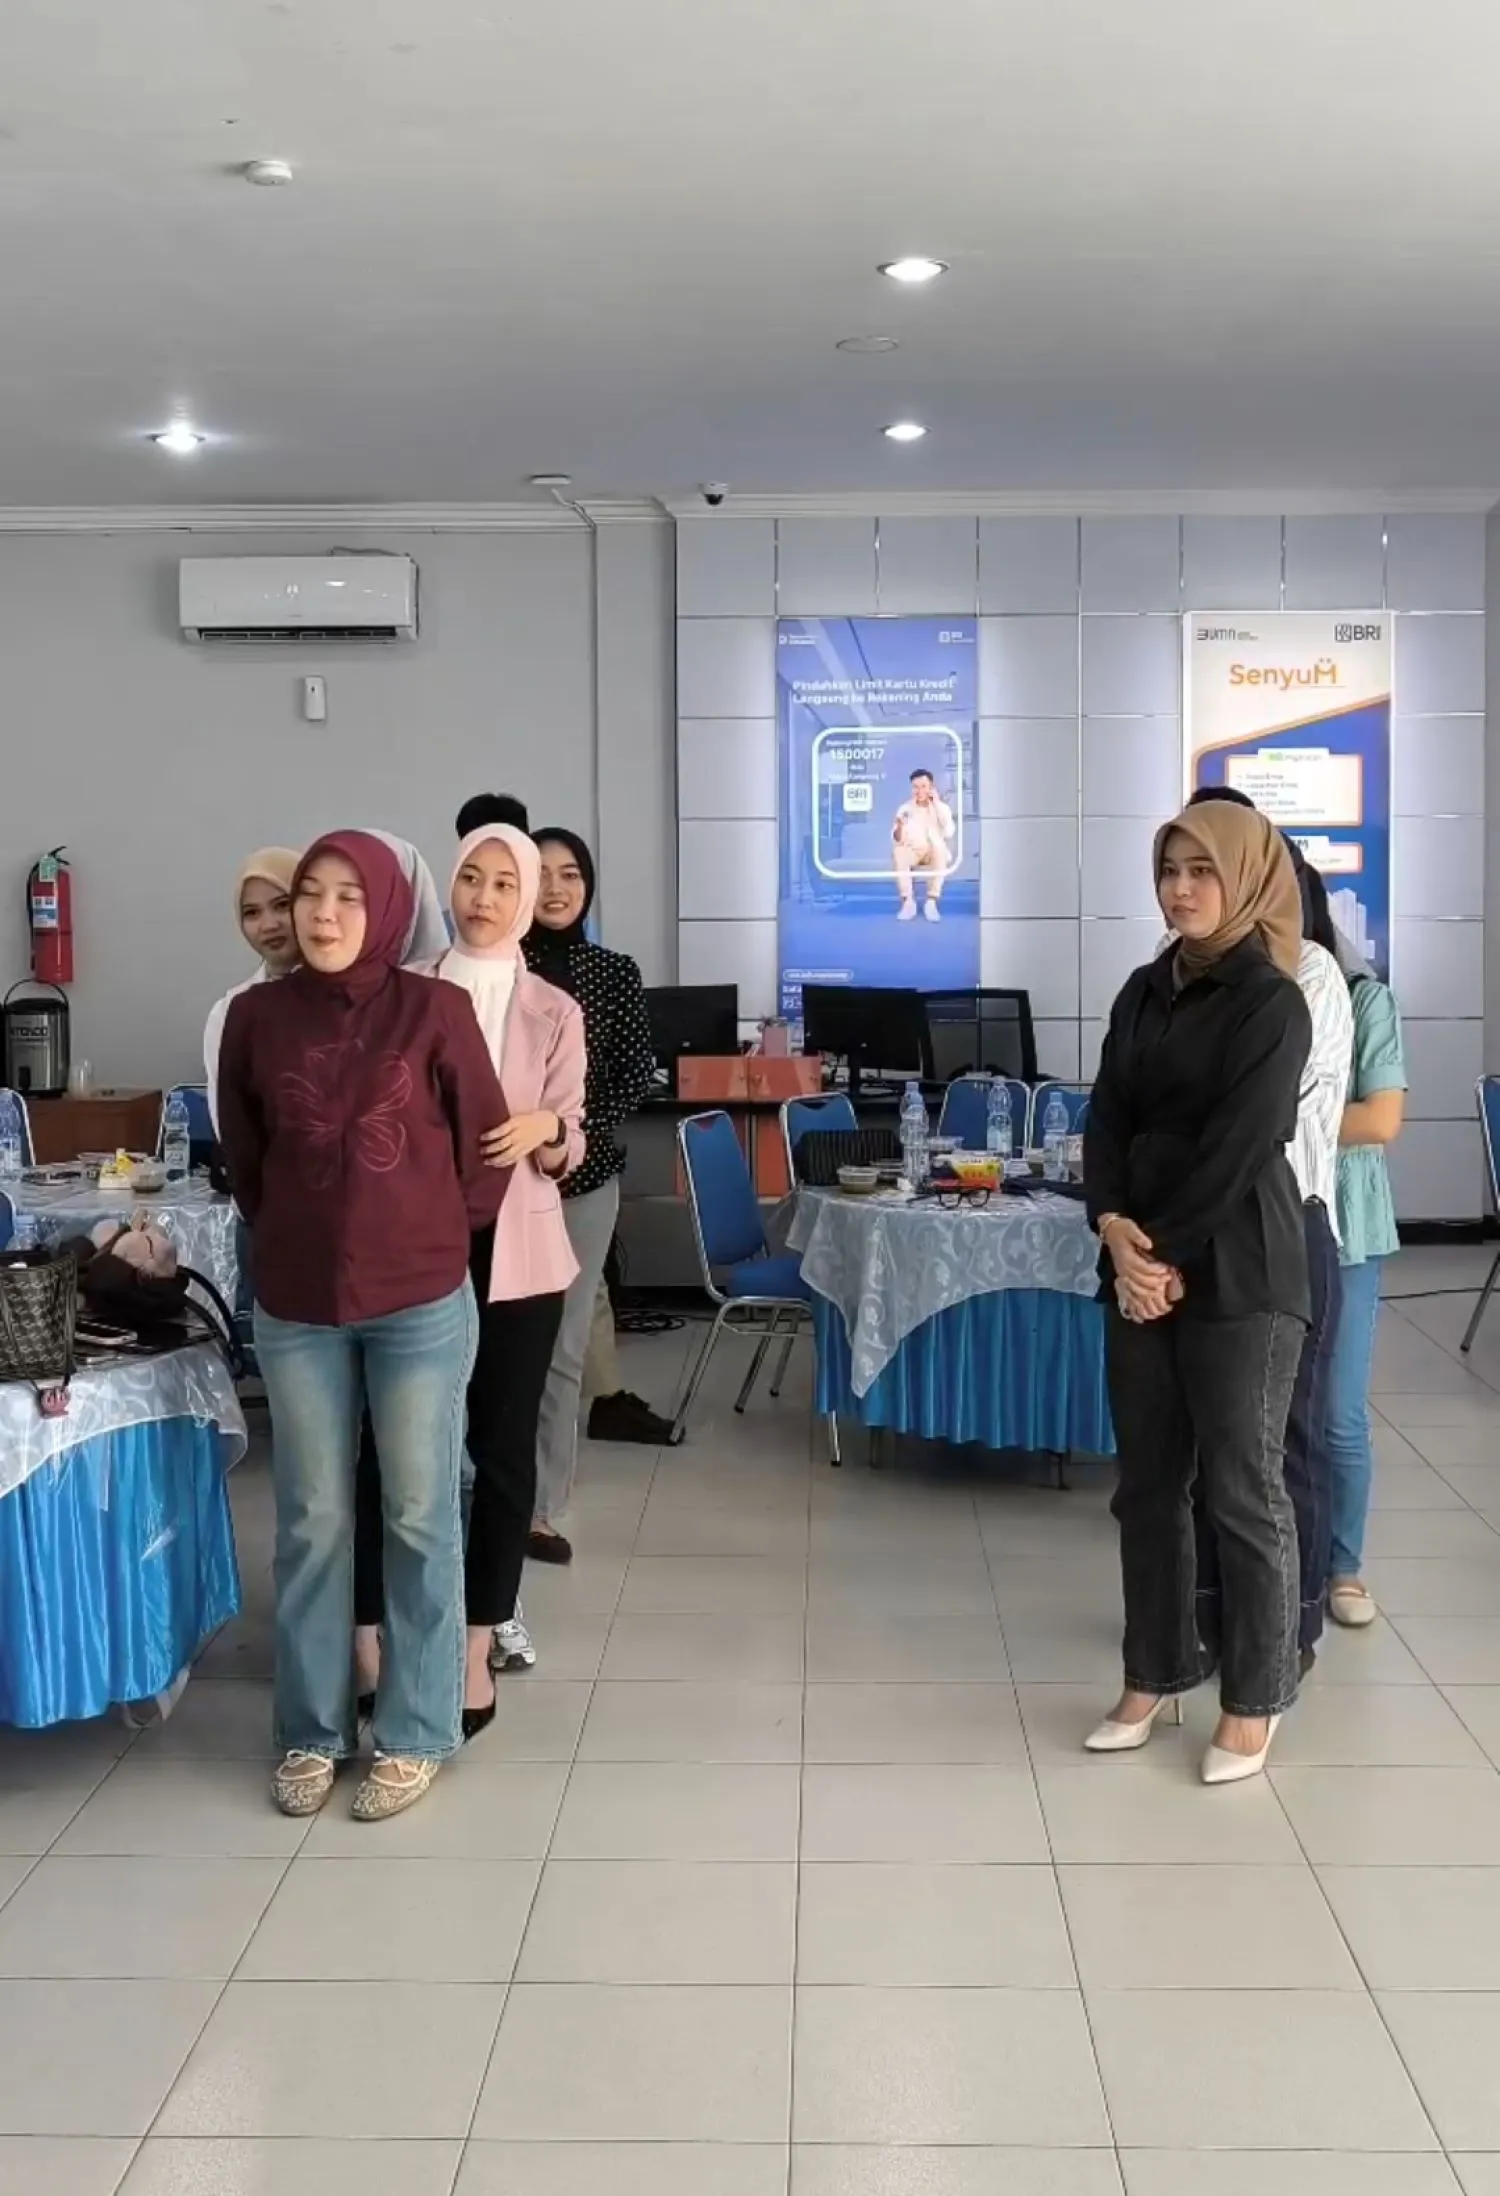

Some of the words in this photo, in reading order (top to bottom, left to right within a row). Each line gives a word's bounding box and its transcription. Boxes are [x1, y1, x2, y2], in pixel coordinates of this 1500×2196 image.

[1353, 625, 1381, 641] BRI
[885, 679, 917, 690] Kartu
[867, 692, 919, 705] Rekening
[922, 692, 953, 703] Anda
[830, 747, 885, 760] 1500017
